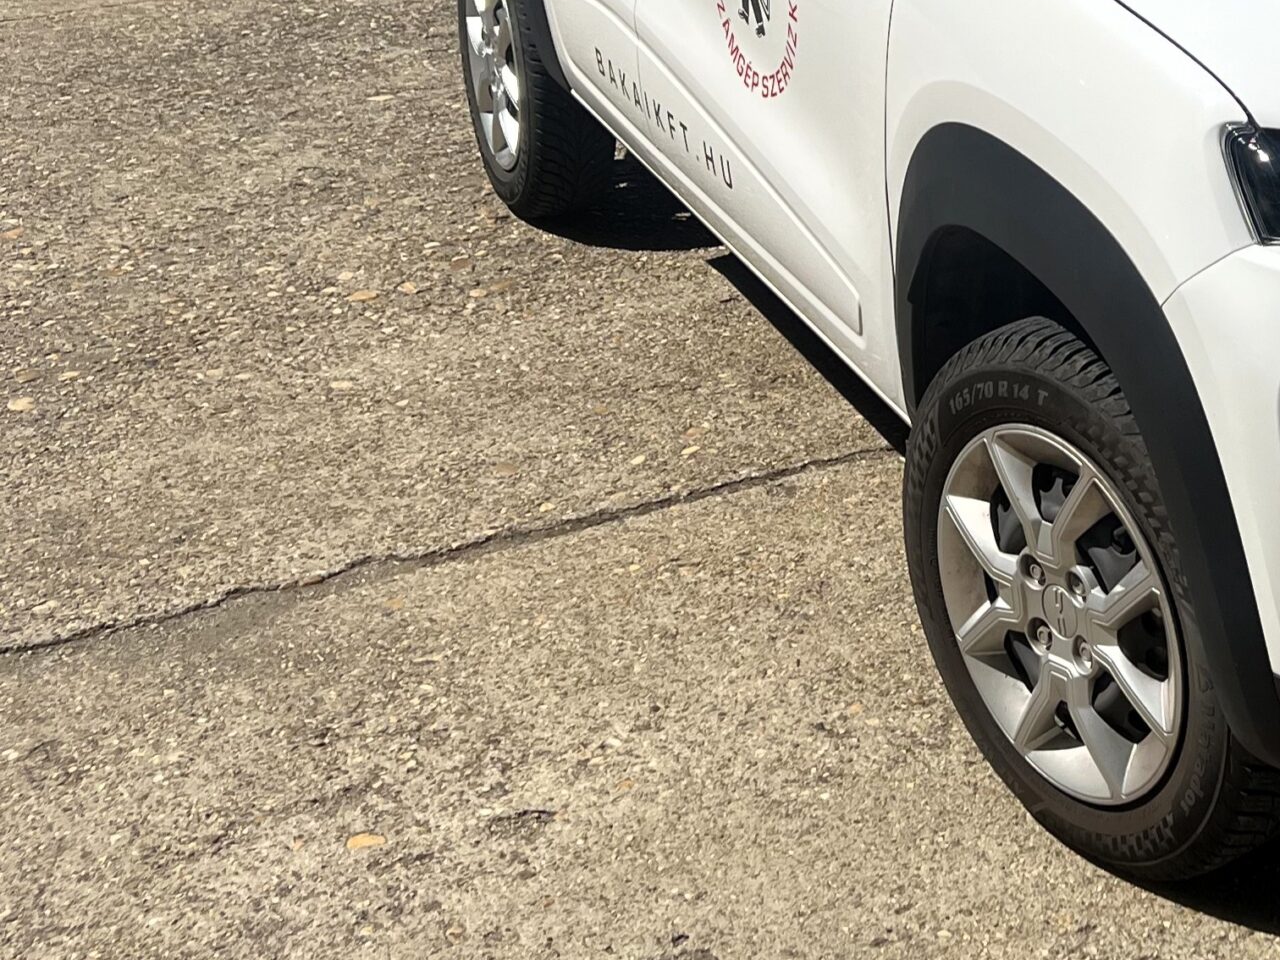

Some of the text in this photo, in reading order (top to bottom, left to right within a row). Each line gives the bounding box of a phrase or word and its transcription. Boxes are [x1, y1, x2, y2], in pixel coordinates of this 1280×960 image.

[594, 47, 733, 189] BAKAIKFT.HU
[949, 381, 1049, 415] 165/70 R 14 T
